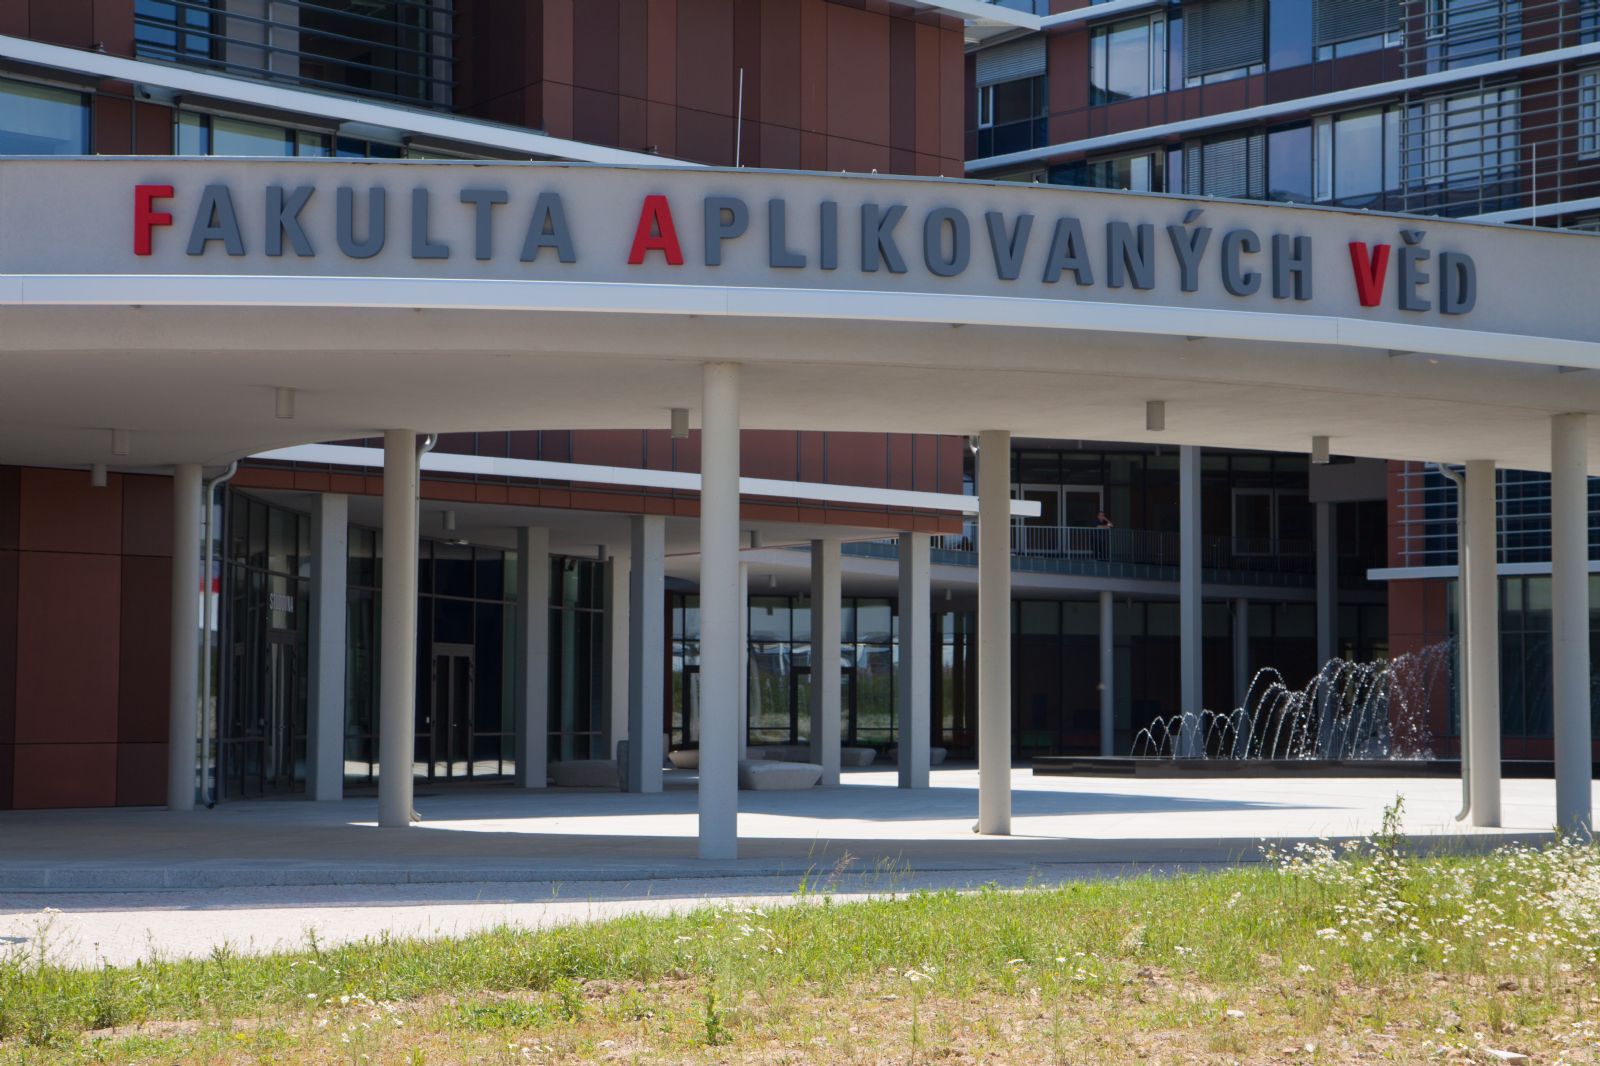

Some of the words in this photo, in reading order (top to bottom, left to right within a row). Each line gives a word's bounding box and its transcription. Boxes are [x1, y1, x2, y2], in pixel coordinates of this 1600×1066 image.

[133, 184, 577, 263] FAKULTA
[627, 194, 1313, 301] APLIKOVANÝCH
[1348, 230, 1476, 315] VĚD
